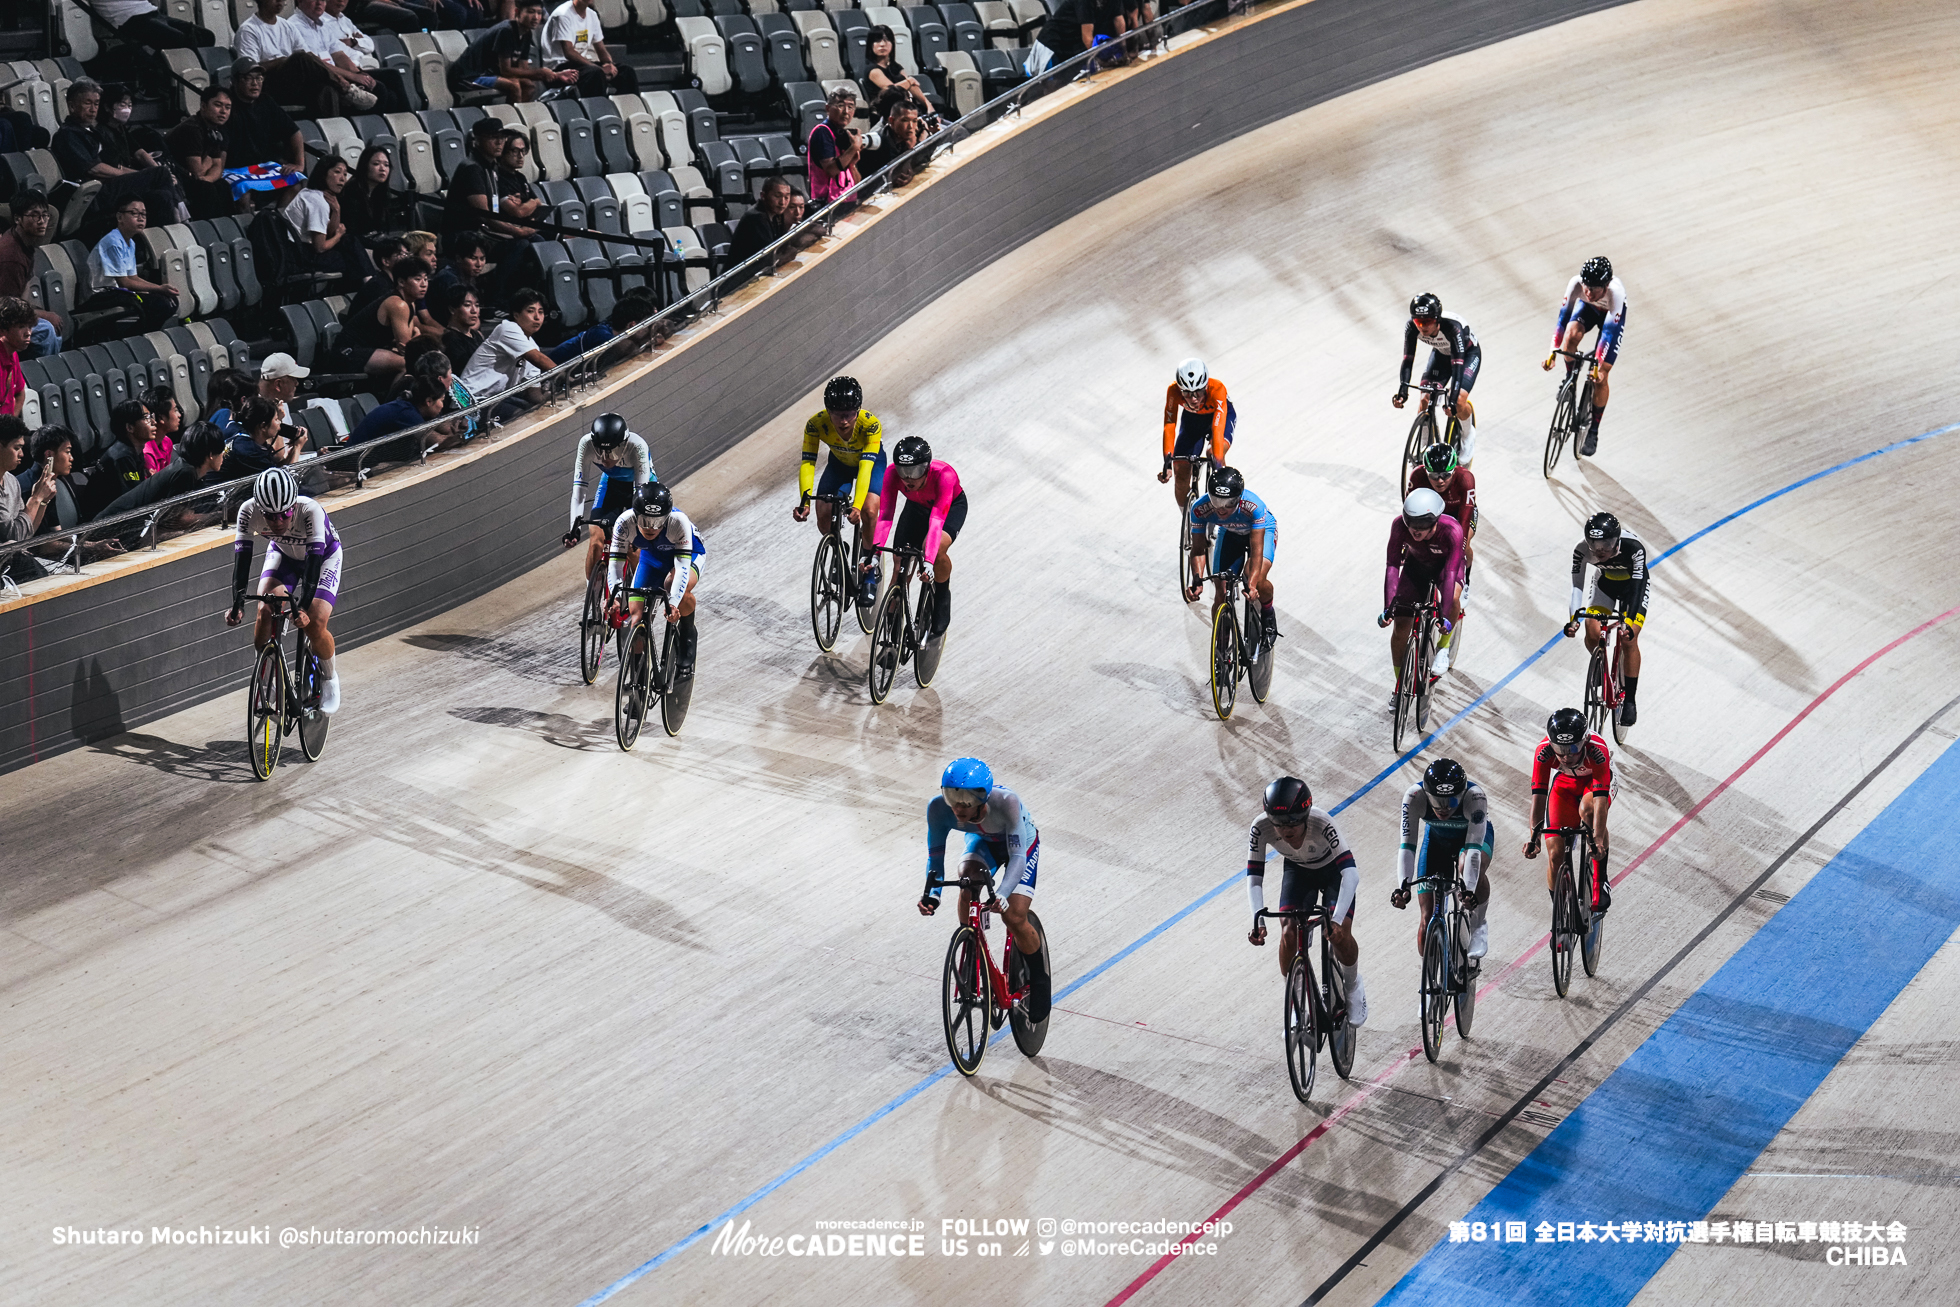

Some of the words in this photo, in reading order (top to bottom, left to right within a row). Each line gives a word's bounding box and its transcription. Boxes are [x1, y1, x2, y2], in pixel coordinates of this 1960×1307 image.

[1402, 803, 1411, 837] KANSAI
[1249, 825, 1262, 853] KEIO
[1322, 823, 1340, 849] KEIO
